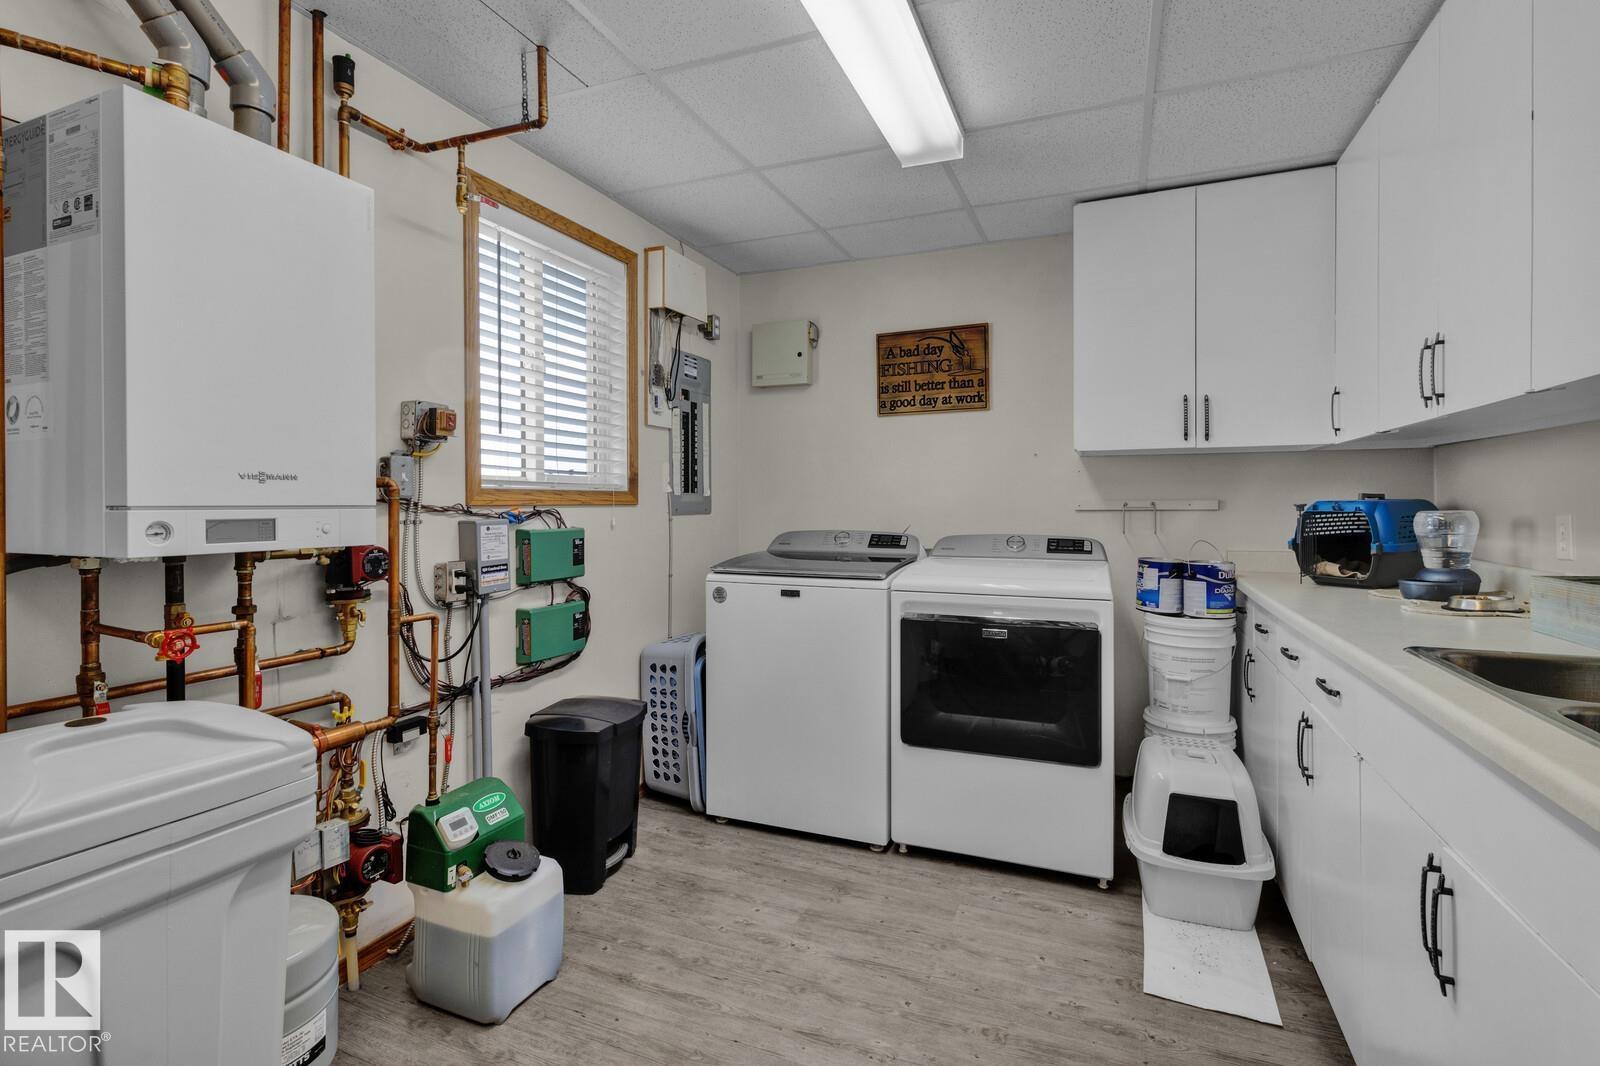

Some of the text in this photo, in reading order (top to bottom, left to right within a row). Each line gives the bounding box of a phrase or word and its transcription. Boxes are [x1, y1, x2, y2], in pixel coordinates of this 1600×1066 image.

[4, 122, 46, 147] NERGYGUIDE
[886, 343, 944, 359] A bad day
[880, 359, 953, 377] FISHING
[880, 377, 984, 394] is still better than a
[880, 392, 984, 411] a good day at work
